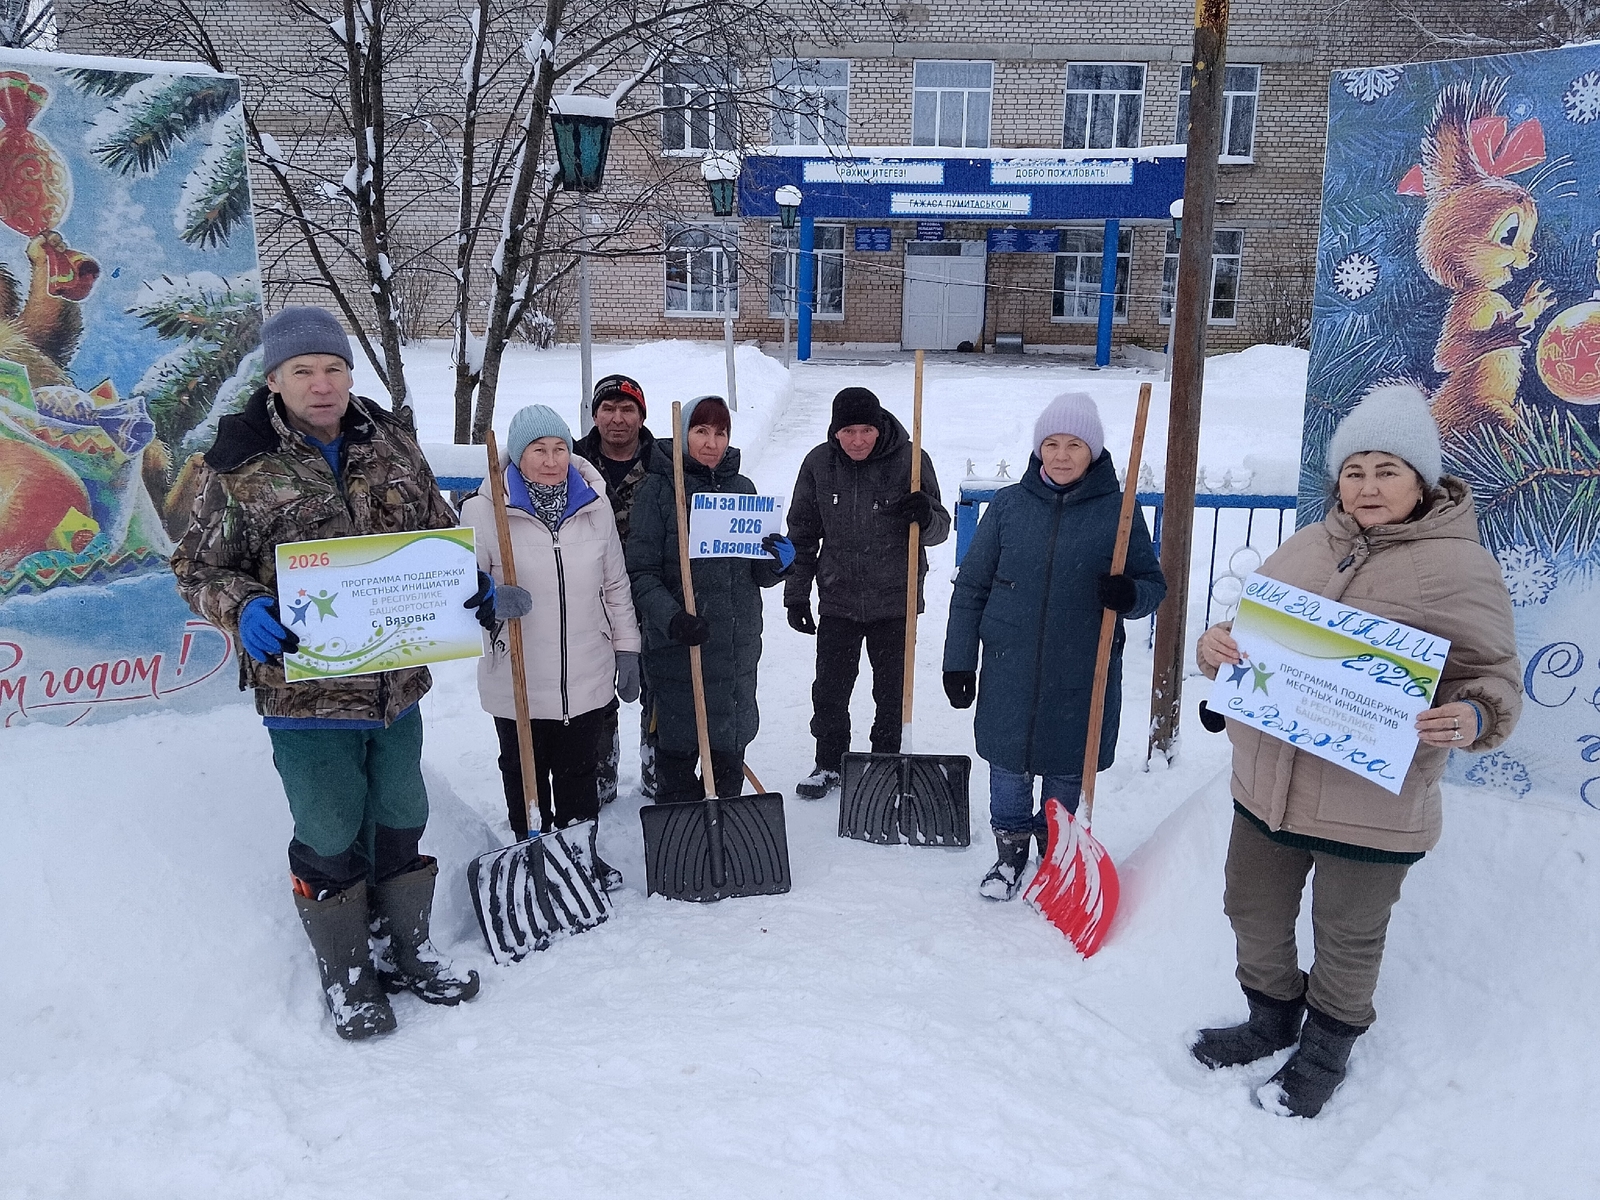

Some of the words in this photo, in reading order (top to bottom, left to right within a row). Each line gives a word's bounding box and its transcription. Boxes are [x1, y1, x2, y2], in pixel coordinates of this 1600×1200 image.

[1016, 169, 1044, 178] ДОБРО
[1048, 169, 1109, 178] ПОЖАЛОВАТЬ!
[694, 494, 717, 510] Мы
[719, 497, 736, 511] за
[738, 495, 775, 512] ППМИ
[729, 518, 763, 534] 2026
[700, 541, 710, 554] с.
[288, 552, 330, 570] 2026
[341, 575, 401, 588] ПРОГРАММА
[403, 568, 466, 582] ПОДДЕРЖКИ
[352, 586, 399, 598] МЕСТНЫХ
[402, 578, 460, 593] ИНИЦИАТИВ
[372, 598, 379, 606] В
[381, 590, 443, 604] РЕСПУБЛИКЕ
[369, 600, 448, 616] БАШКОРТОСТАН
[371, 618, 382, 629] с.
[385, 612, 436, 627] Вязовка
[1342, 654, 1432, 697] 2026
[1280, 663, 1338, 693] ПРОГРАММА
[1341, 687, 1409, 721] ПОДДЕРЖКИ
[1286, 679, 1332, 703] МЕСТНЫХ
[1335, 698, 1398, 730] ИНИЦИАТИВ
[1301, 697, 1307, 706] В
[1311, 700, 1375, 732] РЕСПУБЛИКЕ
[1295, 707, 1376, 746] БАШКОРТОСТАН
